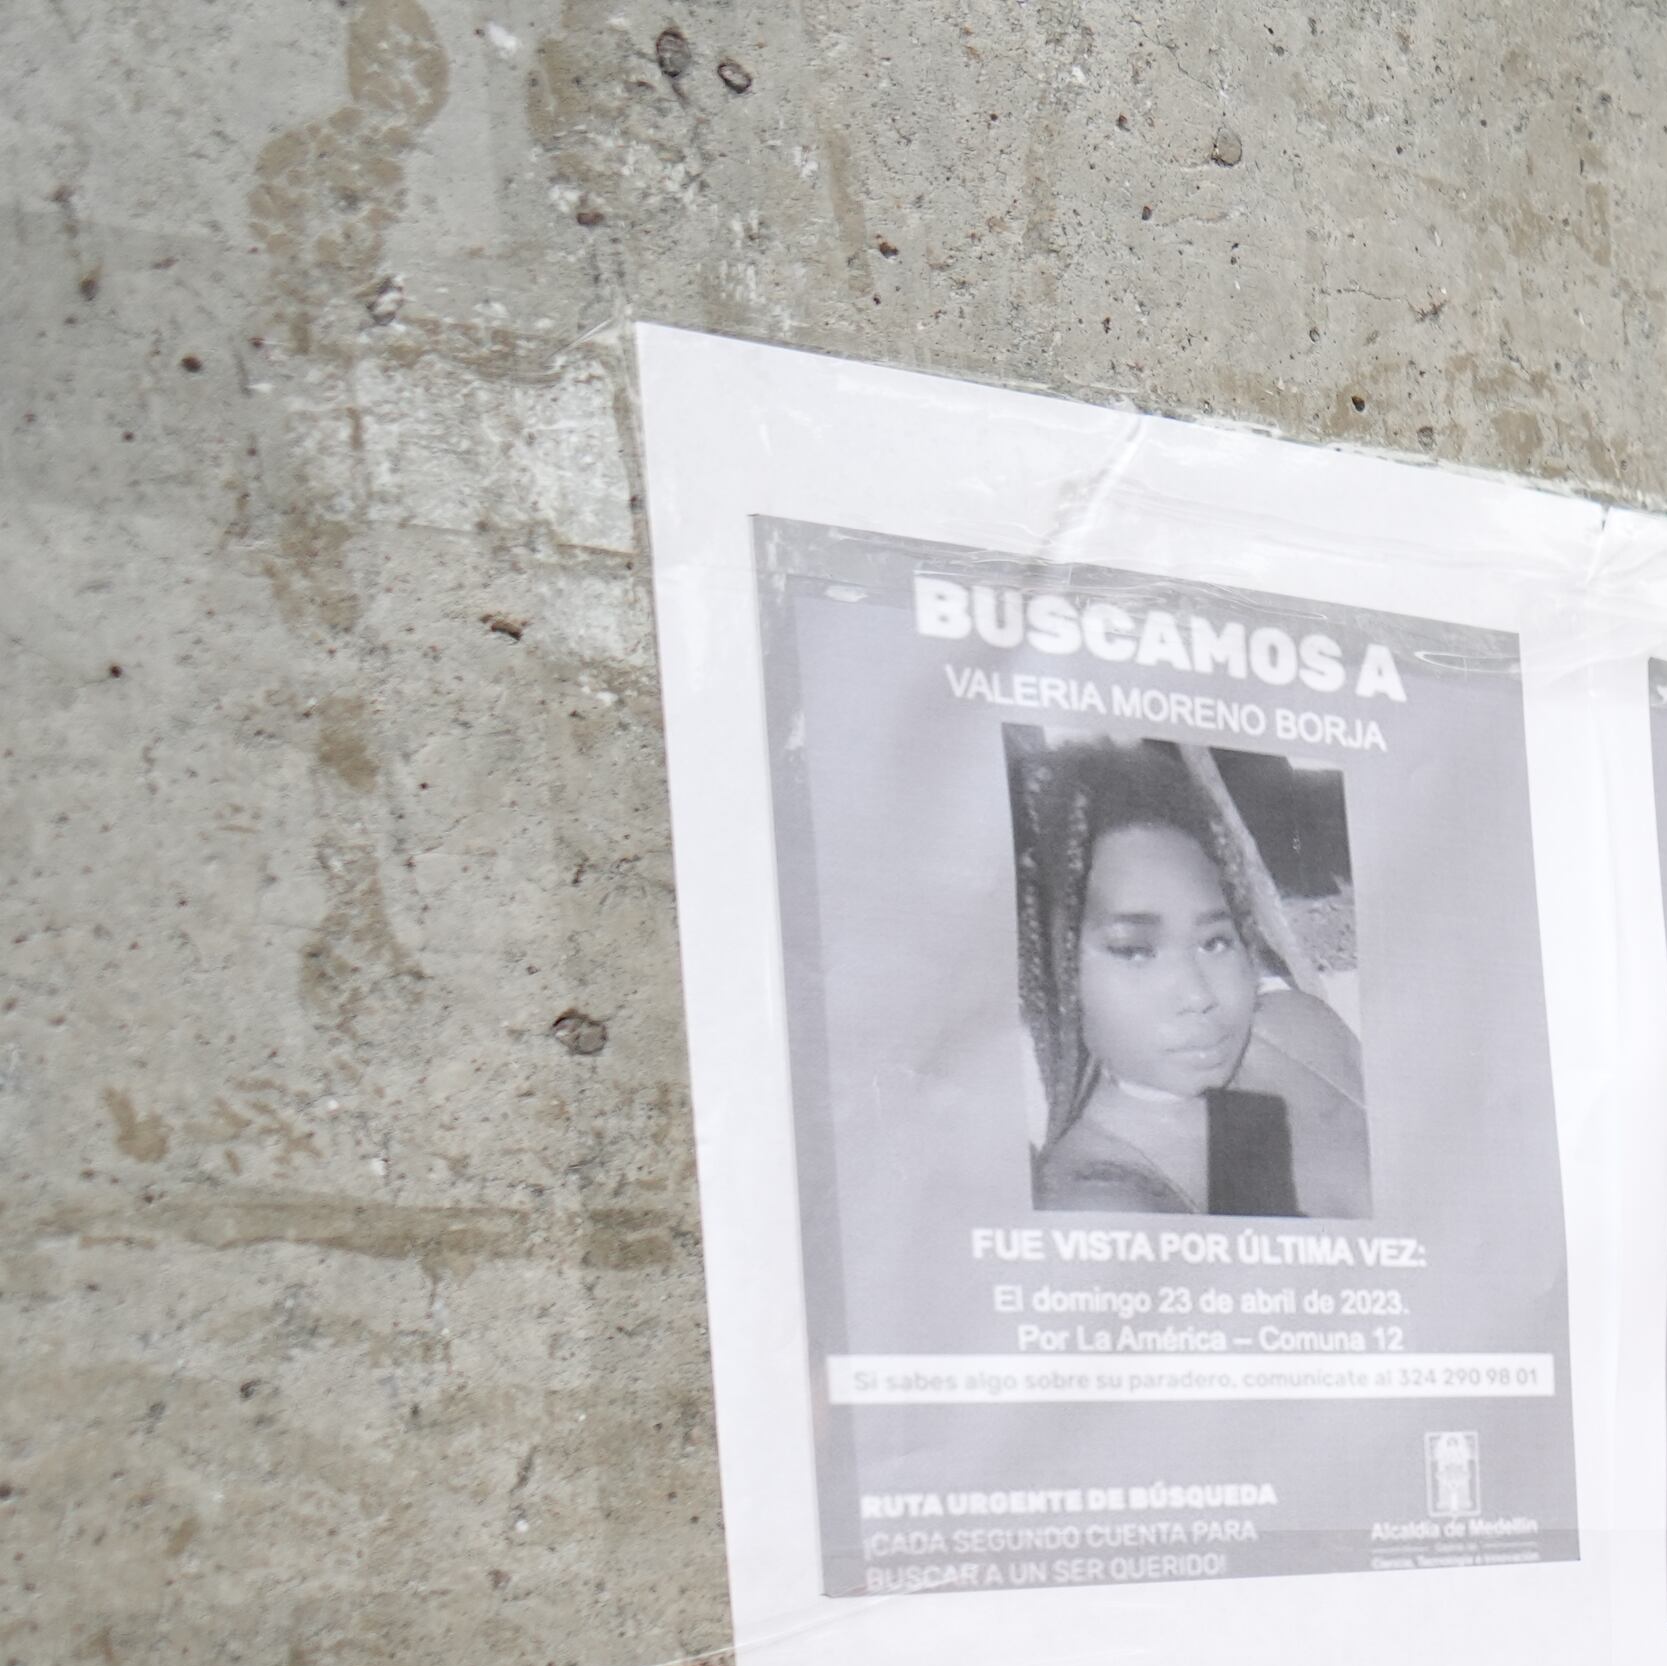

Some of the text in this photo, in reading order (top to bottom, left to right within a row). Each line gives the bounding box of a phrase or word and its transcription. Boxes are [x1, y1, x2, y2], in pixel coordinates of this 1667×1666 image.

[912, 574, 1407, 703] BUSCAMOS A
[944, 663, 1388, 752] VALERIA MORENO BORJA
[971, 1228, 1428, 1269] FUE VISTA POR ÚLTIMA VEZ:
[993, 1283, 1410, 1320] El domingo 23 de abril de 2023.
[1017, 1324, 1070, 1353] Por
[1077, 1325, 1115, 1353] La
[1115, 1323, 1227, 1353] América
[1258, 1325, 1366, 1353] Comuna
[1372, 1325, 1404, 1353] 12
[853, 1369, 878, 1392] Si
[885, 1368, 958, 1391] sabes
[963, 1369, 1018, 1396] algo
[1024, 1369, 1089, 1391] sobre
[1096, 1372, 1123, 1391] su
[1129, 1369, 1238, 1397] paradero,
[1374, 1367, 1393, 1388] al
[1398, 1368, 1437, 1388] 324
[1443, 1367, 1481, 1387] 290
[1486, 1366, 1512, 1387] 98
[1516, 1366, 1538, 1386] 01
[861, 1480, 1279, 1520] RUTA URGENTE DE BÚSQUEDA
[952, 1525, 1080, 1555] SEGUNDO
[1085, 1521, 1184, 1550] CUENTA
[1192, 1518, 1259, 1545] PARA
[983, 1563, 1006, 1586] A
[1009, 1559, 1048, 1585] UN
[1053, 1556, 1106, 1583] SER
